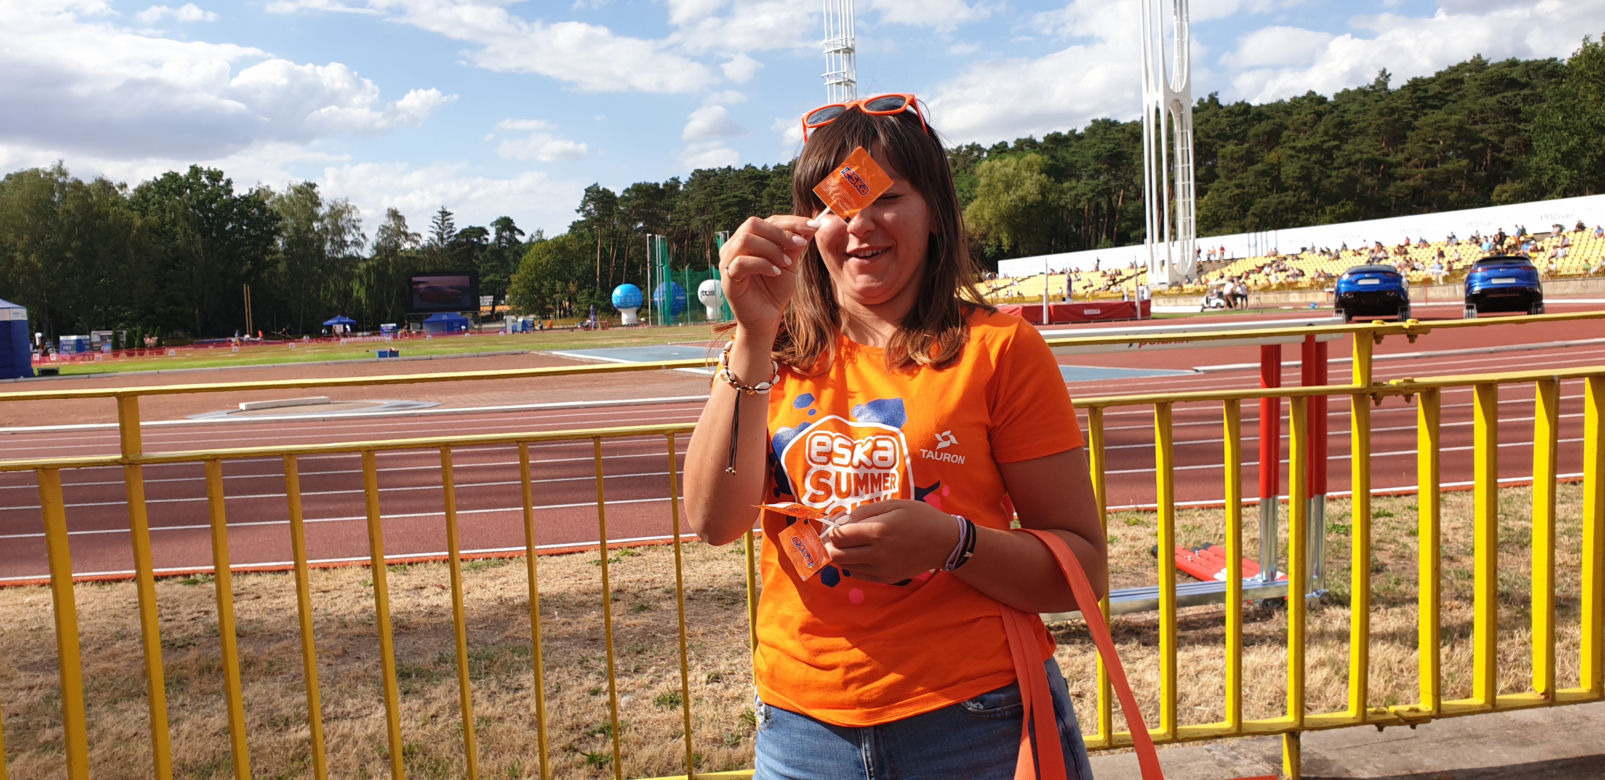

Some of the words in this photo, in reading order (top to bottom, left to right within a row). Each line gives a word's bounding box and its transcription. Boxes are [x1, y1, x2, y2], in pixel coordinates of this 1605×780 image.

[843, 170, 870, 196] eska
[810, 434, 895, 469] eska
[919, 448, 966, 465] TAURON
[808, 469, 897, 503] SUMMER
